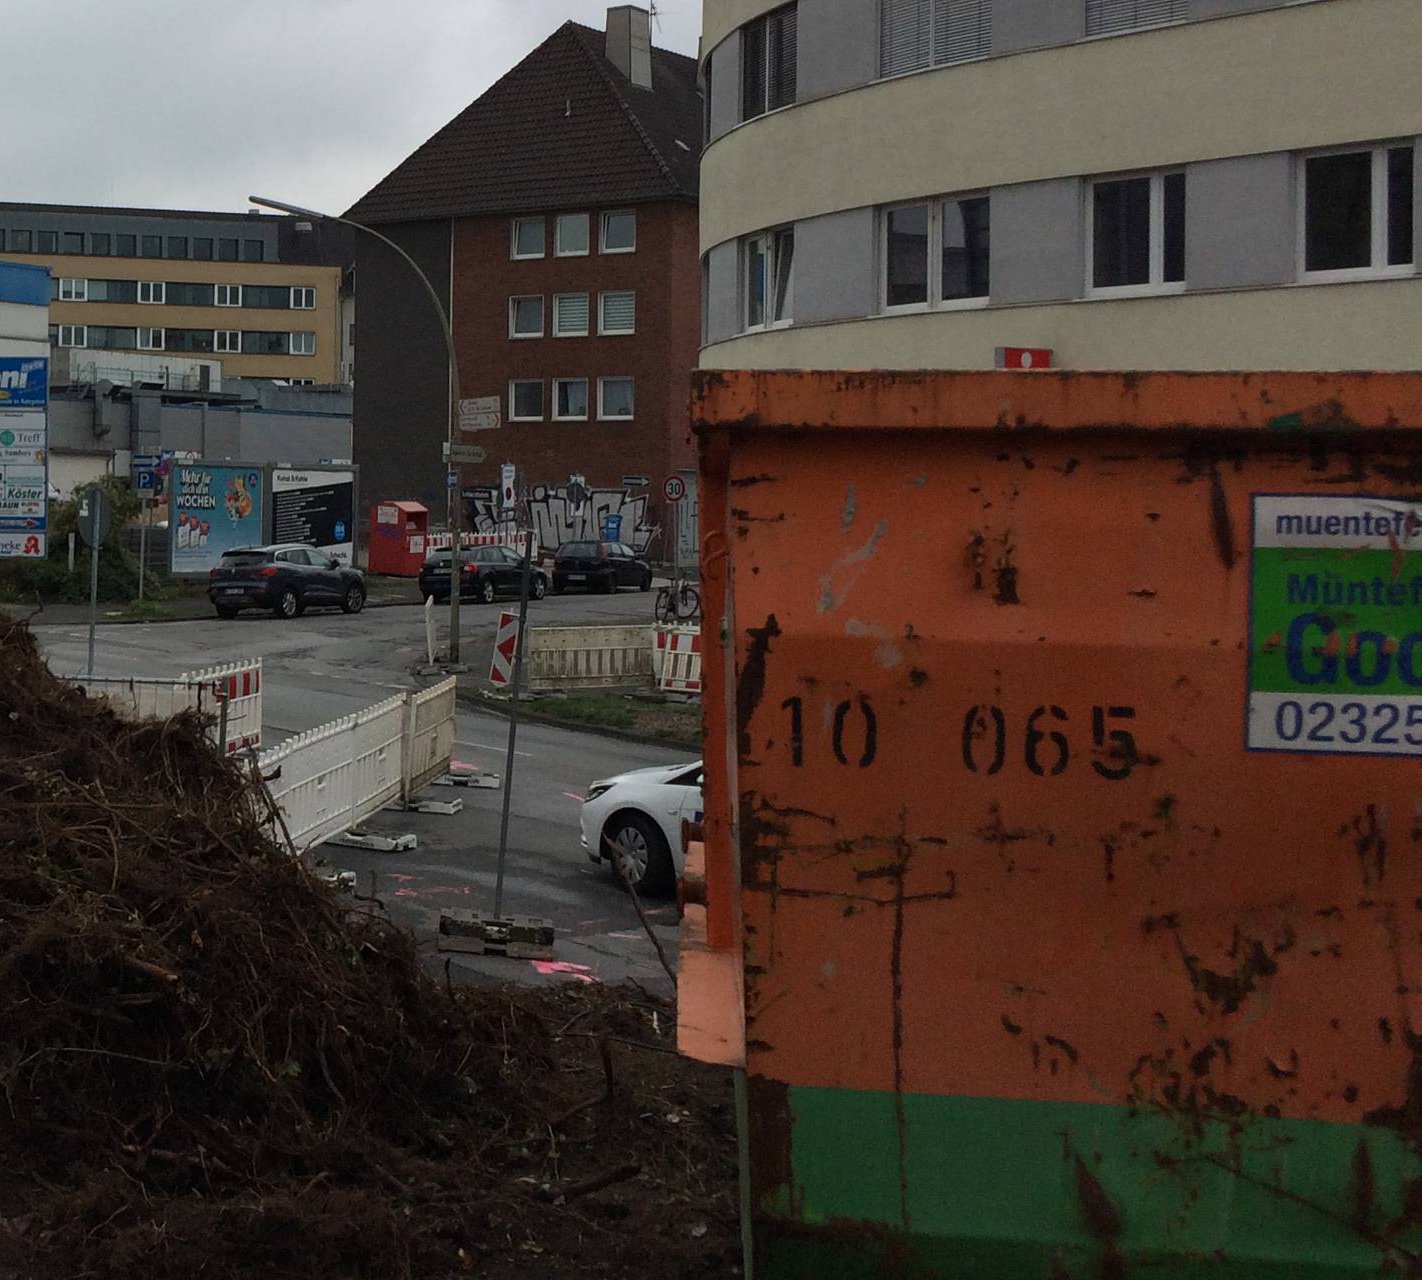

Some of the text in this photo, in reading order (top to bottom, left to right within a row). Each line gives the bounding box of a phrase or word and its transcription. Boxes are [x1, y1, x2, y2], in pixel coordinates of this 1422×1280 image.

[18, 433, 42, 442] Treff
[7, 488, 42, 499] Köster
[667, 482, 680, 495] 30
[177, 495, 216, 508] WOCHEN
[1275, 699, 1422, 746] 02325
[781, 697, 1138, 780] 10 065
